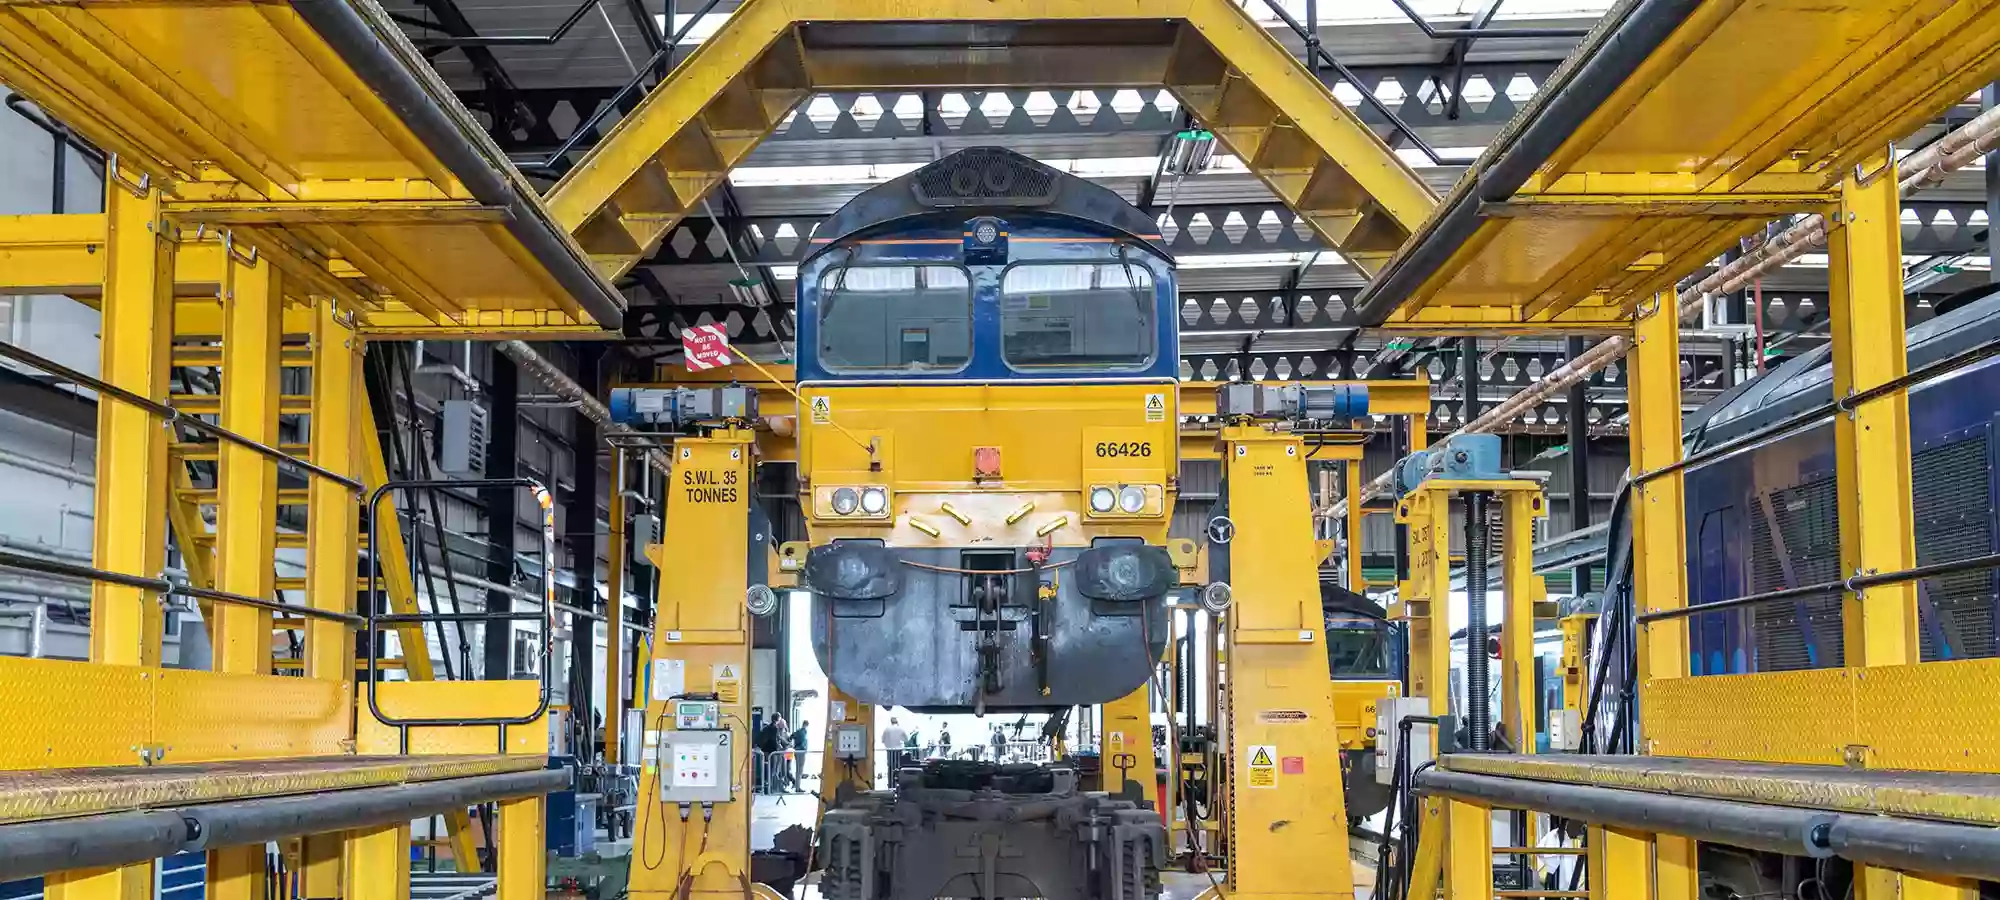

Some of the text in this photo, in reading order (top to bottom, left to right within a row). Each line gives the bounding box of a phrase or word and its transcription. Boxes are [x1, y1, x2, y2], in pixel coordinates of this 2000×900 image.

[694, 336, 706, 344] NOT
[702, 343, 711, 351] BE
[696, 350, 719, 360] MOVED
[1096, 442, 1152, 458] 66426
[684, 470, 737, 485] S.W.L. 35
[686, 488, 737, 503] TONNES
[1365, 705, 1377, 714] 66
[719, 733, 729, 747] 2
